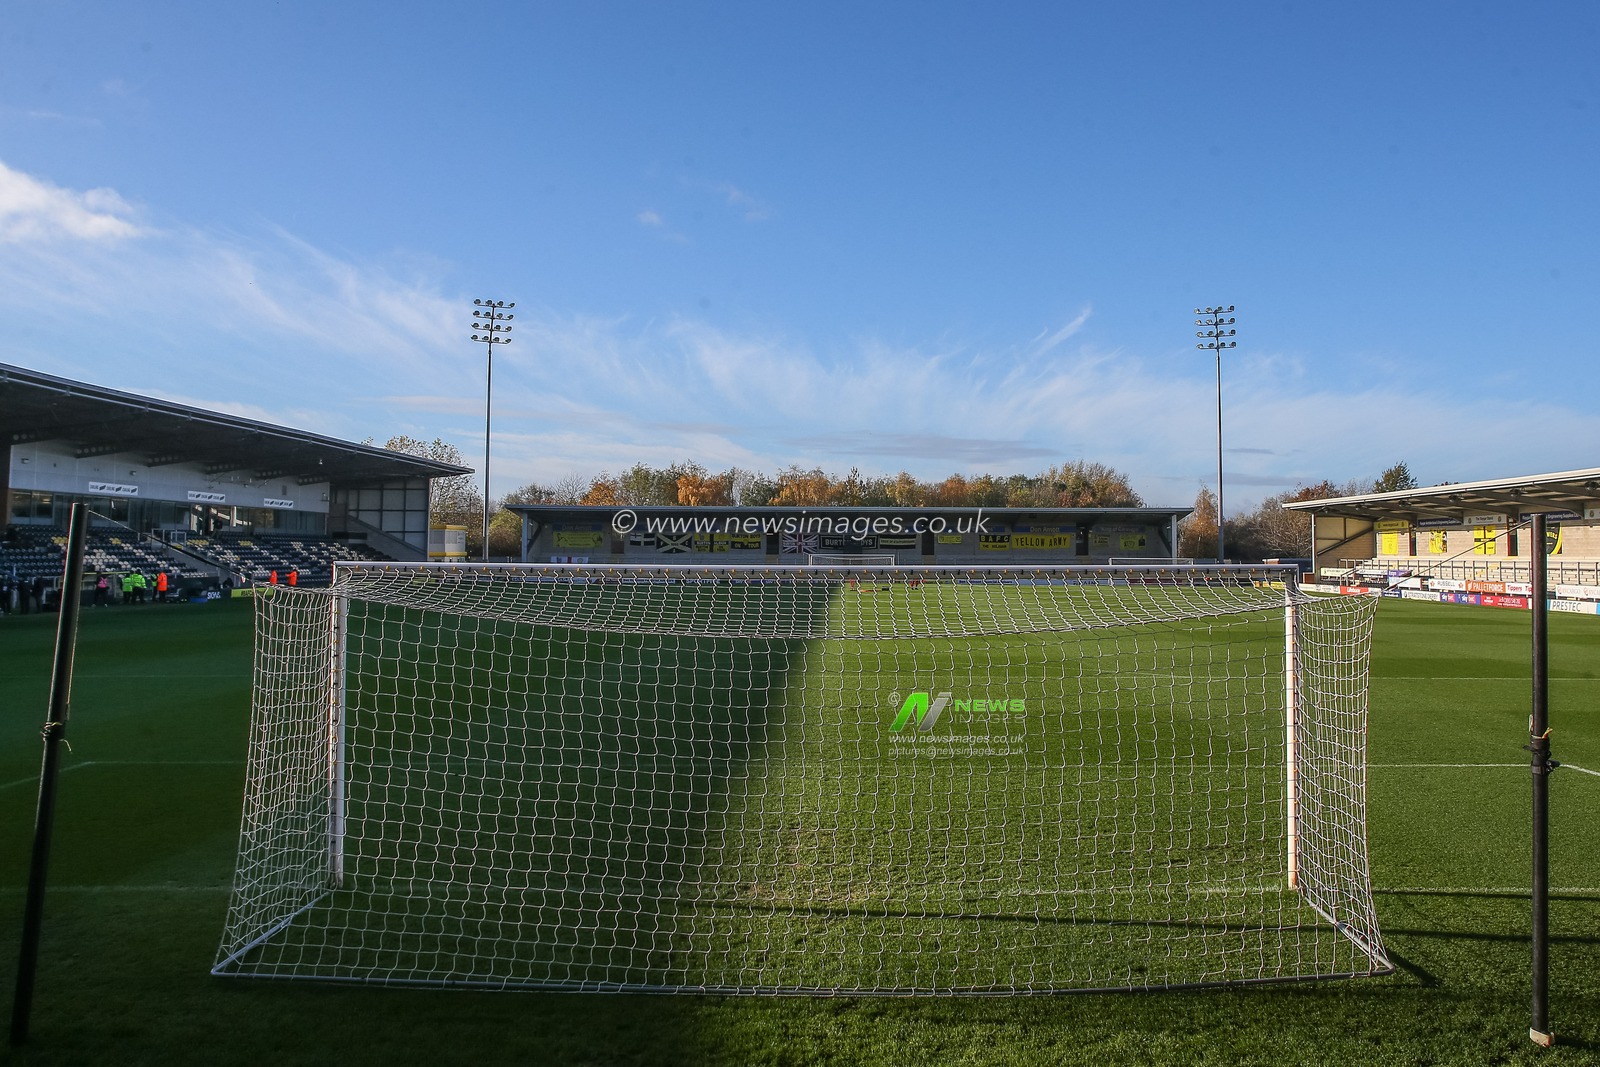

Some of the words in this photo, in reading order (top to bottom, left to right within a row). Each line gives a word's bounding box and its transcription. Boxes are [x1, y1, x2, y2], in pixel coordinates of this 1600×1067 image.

[1014, 538, 1045, 547] YELLOW
[1048, 536, 1067, 548] ARMY
[1473, 582, 1503, 592] PALLETFORCE
[1552, 600, 1582, 612] PRESTEC
